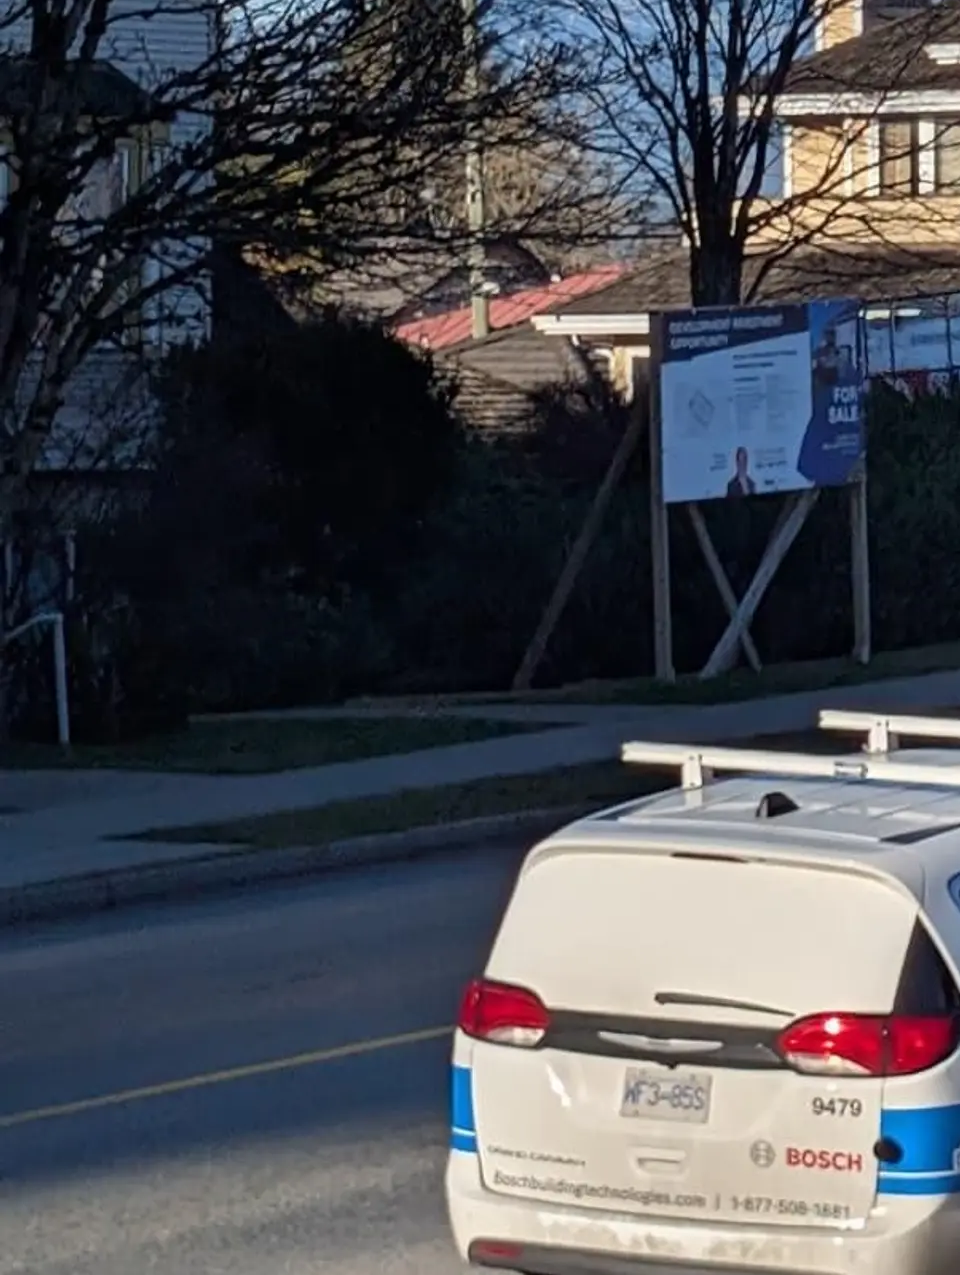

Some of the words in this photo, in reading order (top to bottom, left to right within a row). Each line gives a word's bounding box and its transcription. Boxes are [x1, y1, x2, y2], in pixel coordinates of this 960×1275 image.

[833, 385, 858, 403] FOR
[828, 405, 858, 424] SALE
[812, 1096, 862, 1117] 9479
[786, 1147, 862, 1172] BOSCH
